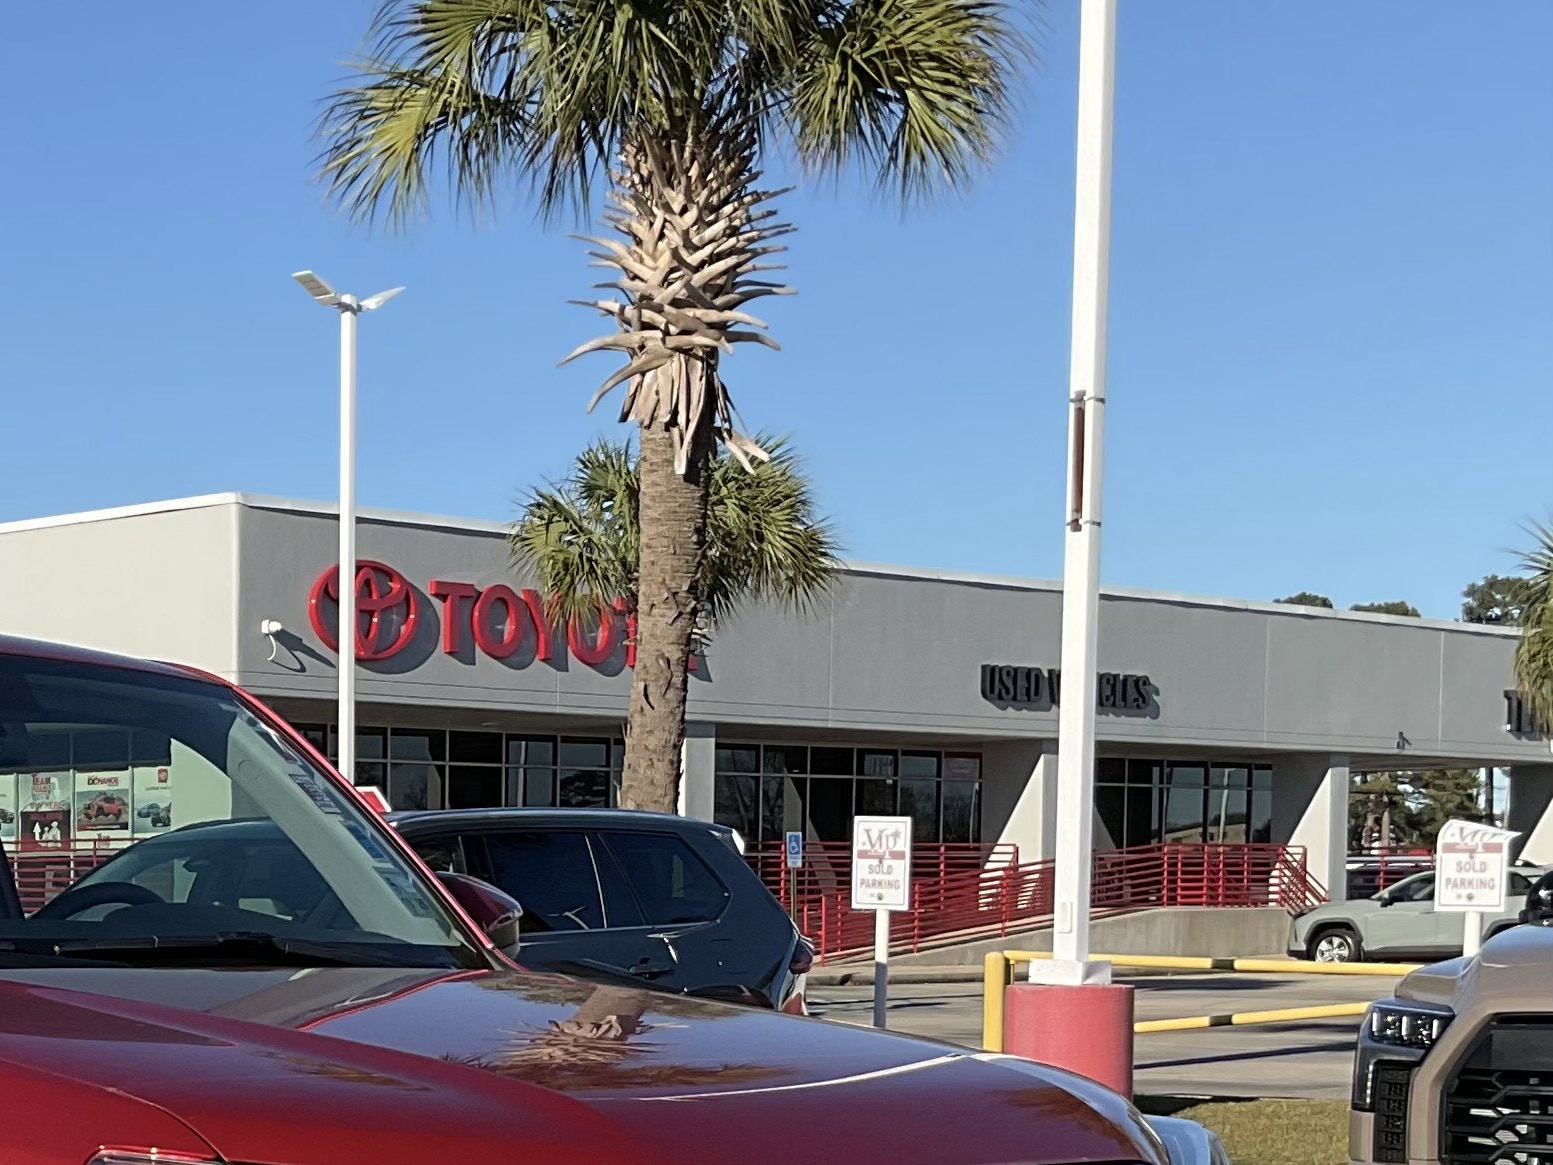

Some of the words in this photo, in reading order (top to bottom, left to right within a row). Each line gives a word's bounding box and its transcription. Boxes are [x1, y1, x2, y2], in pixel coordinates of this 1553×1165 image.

[980, 664, 1047, 709] USED
[867, 864, 893, 875] SOLD
[1455, 860, 1487, 873] SOLD
[859, 878, 901, 890] PARKING
[1445, 877, 1496, 890] PARKING
